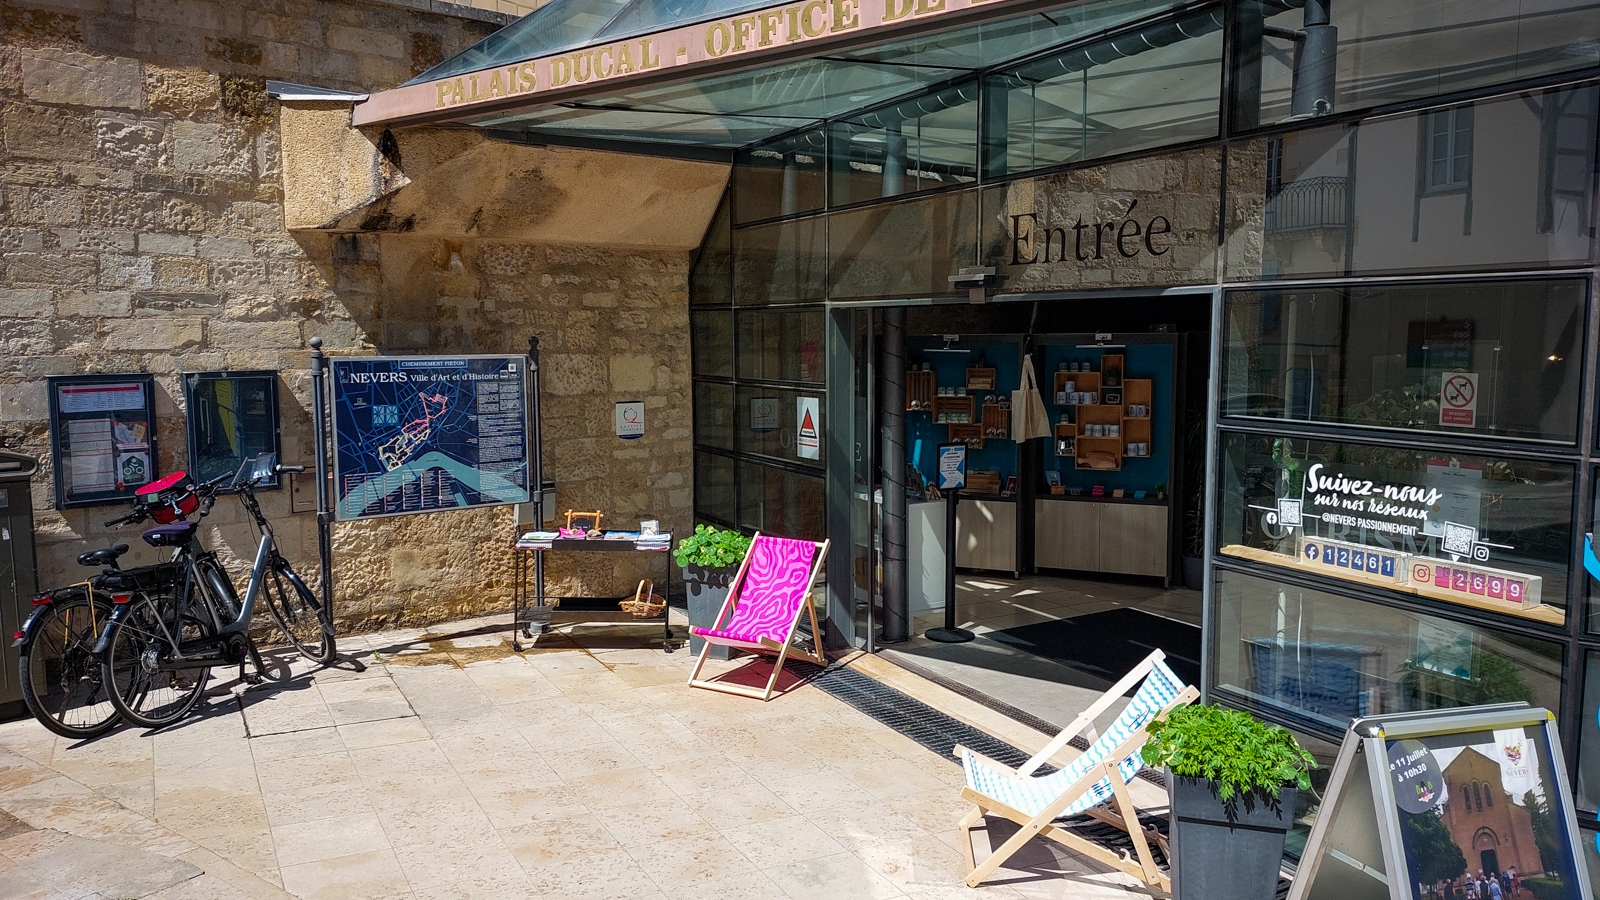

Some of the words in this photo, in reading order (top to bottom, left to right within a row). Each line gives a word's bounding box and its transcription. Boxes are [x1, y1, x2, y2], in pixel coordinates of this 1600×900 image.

[435, 62, 536, 108] PALAIS
[550, 38, 660, 87] DUCAL
[704, 0, 859, 57] OFFICE
[1007, 199, 1171, 266] Entrée
[350, 372, 407, 383] NEVERS
[410, 374, 429, 382] Ville
[430, 373, 450, 382] d'Art
[1306, 463, 1442, 505] Suivez-nous
[1314, 492, 1340, 506] sur
[1342, 498, 1365, 512] nos
[1367, 498, 1430, 521] réseaux
[1321, 512, 1356, 527] @NEVERS
[1357, 516, 1417, 537] PASSIONNEMENT
[1325, 548, 1393, 573] 12461
[1389, 763, 1396, 772] e
[1395, 757, 1406, 767] 11
[1406, 747, 1428, 766] Juillet
[1397, 773, 1404, 783] à
[1404, 763, 1427, 779] 10h30
